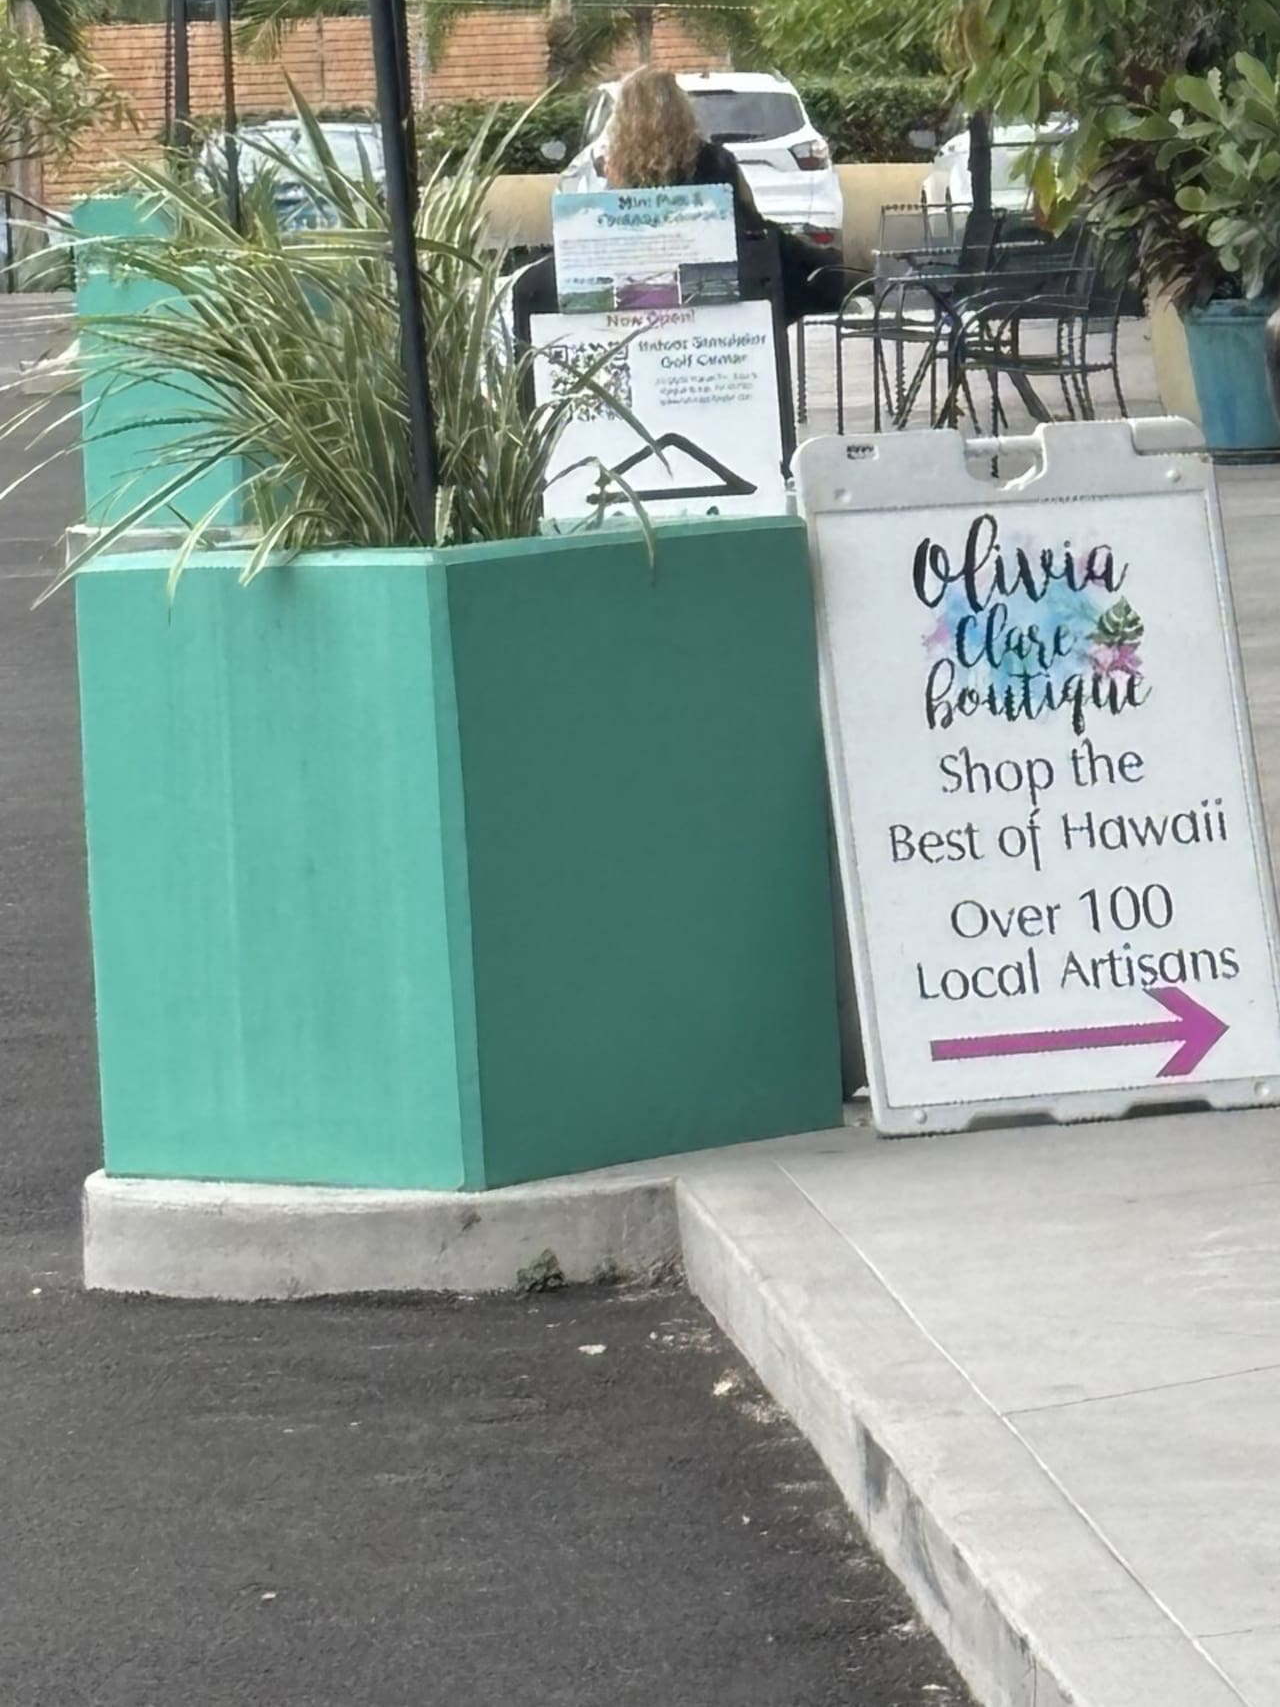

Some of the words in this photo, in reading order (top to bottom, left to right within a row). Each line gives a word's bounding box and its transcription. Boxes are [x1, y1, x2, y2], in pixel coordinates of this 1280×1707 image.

[911, 513, 1129, 610] Olivia
[955, 602, 1078, 670] Clare
[925, 659, 1152, 736] boutique
[942, 746, 1054, 806] Shop
[1070, 738, 1144, 787] the
[891, 822, 984, 864] Best
[999, 809, 1041, 871] of
[1064, 799, 1227, 851] Hawaii
[951, 899, 1061, 939] Over
[1078, 884, 1173, 932] 100
[918, 948, 1040, 1000] Local
[1060, 942, 1240, 987] Artisans
